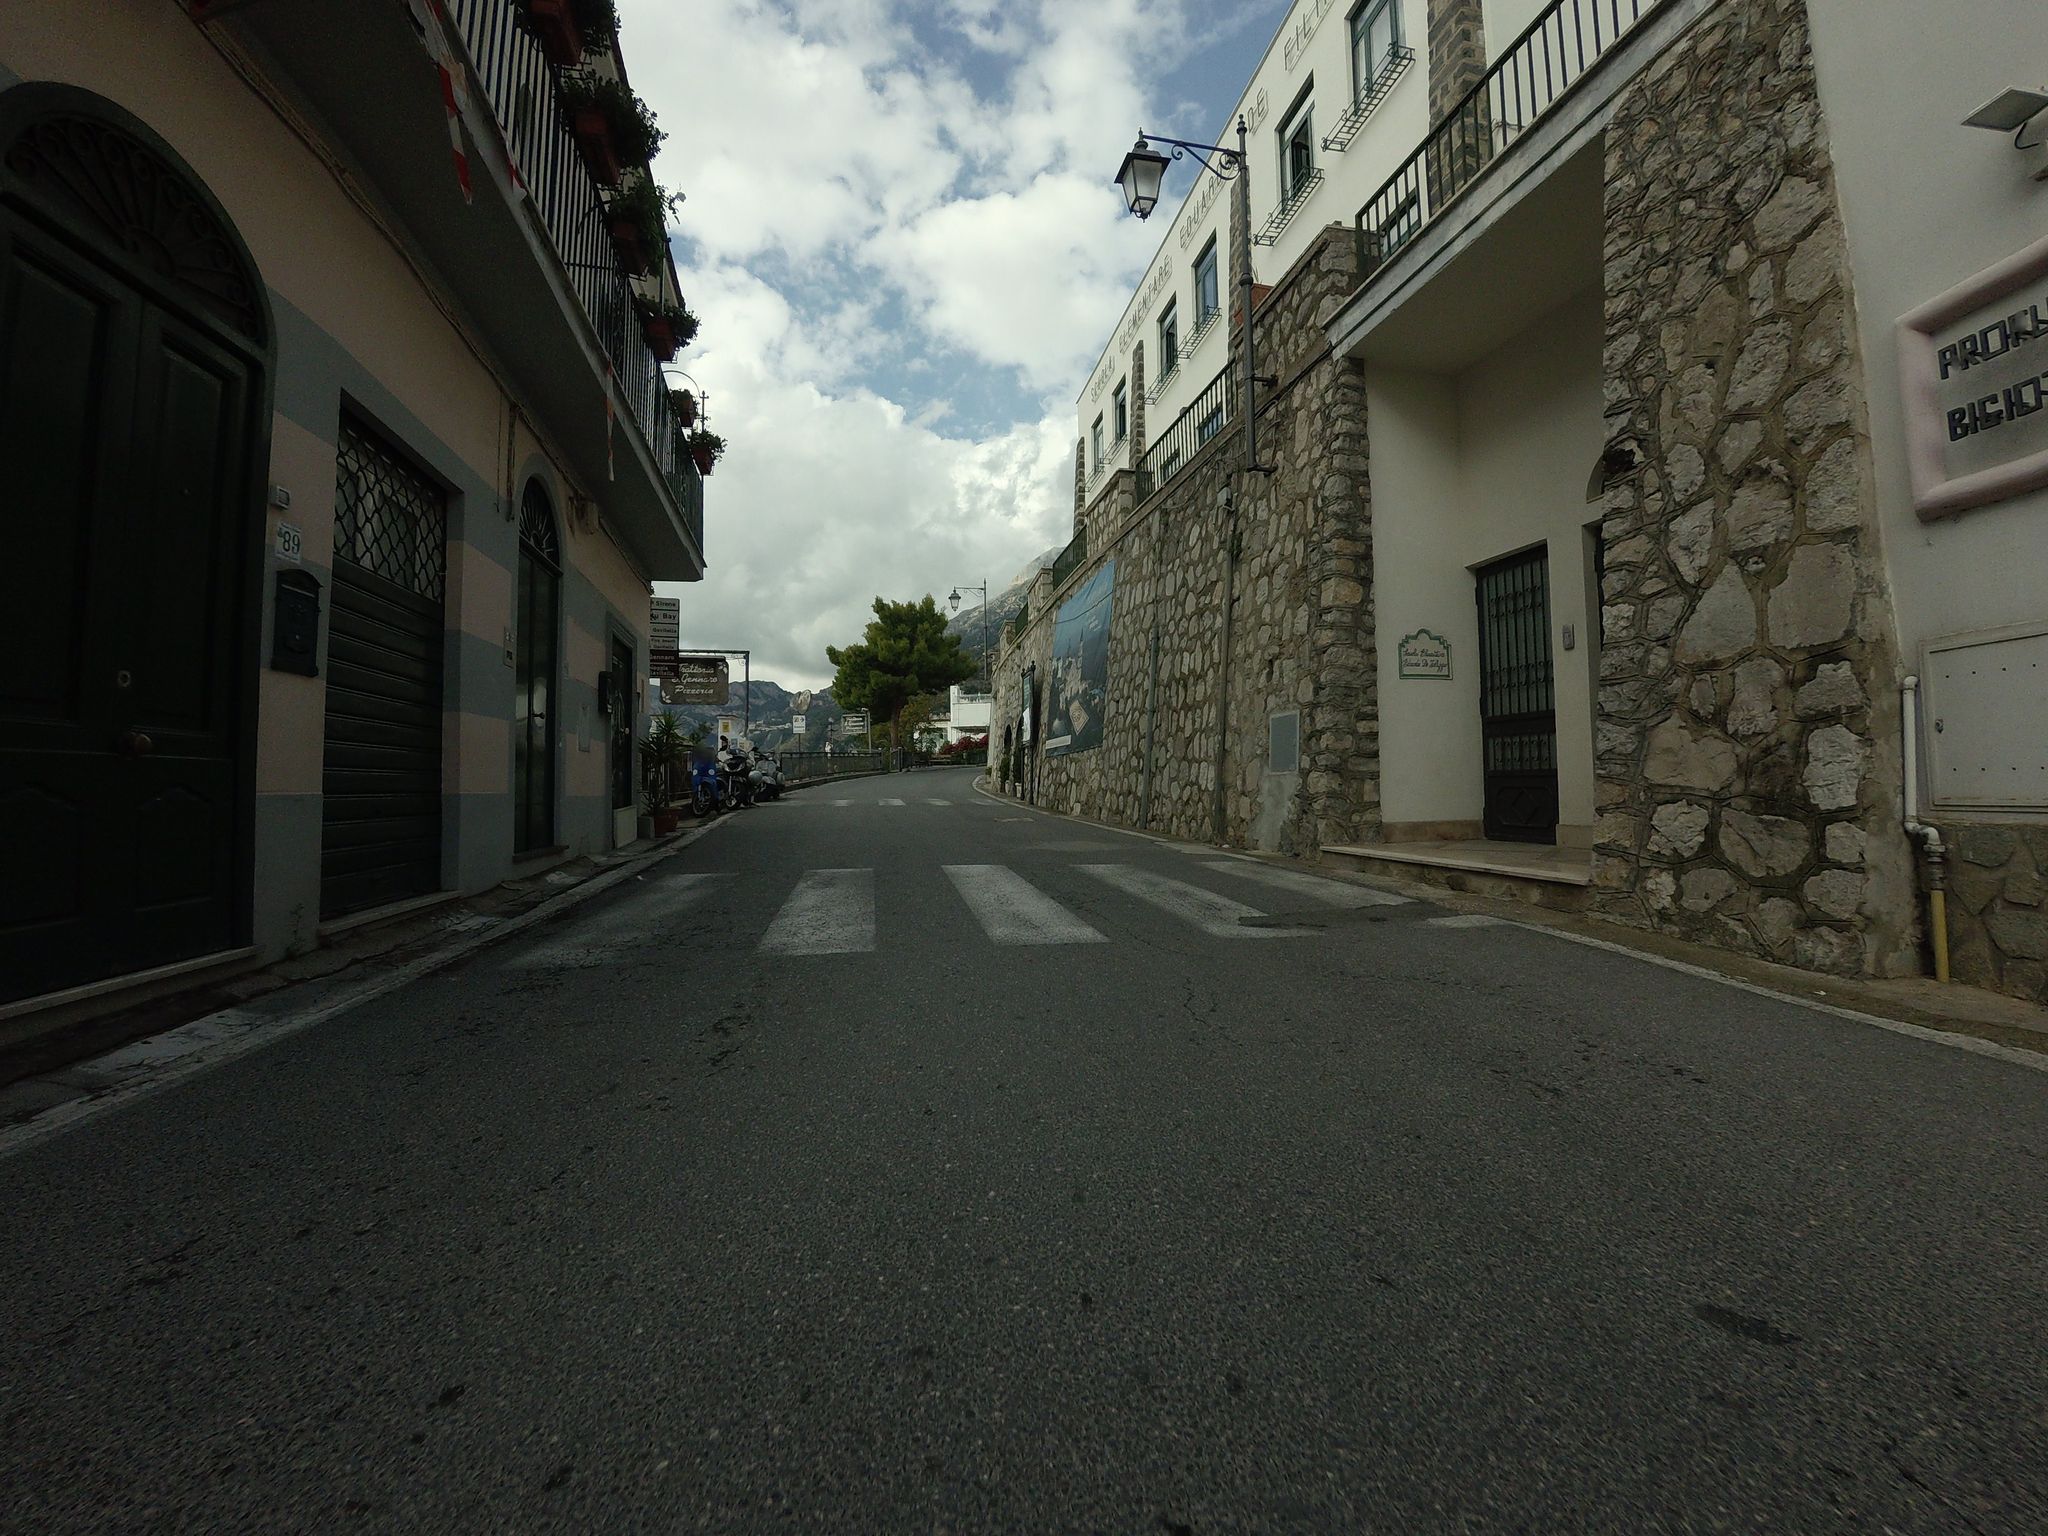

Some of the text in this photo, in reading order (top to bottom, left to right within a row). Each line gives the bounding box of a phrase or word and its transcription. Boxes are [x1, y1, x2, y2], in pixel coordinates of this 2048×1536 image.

[1180, 153, 1231, 249] EDUARD
[1247, 87, 1265, 134] DE
[1284, 0, 1328, 71] FILI
[1946, 370, 2048, 442] BIGIO
[282, 530, 301, 555] 89
[662, 612, 677, 621] Bay
[679, 663, 714, 673] Trattoria
[681, 673, 718, 685] Gennaro
[674, 685, 714, 695] Pizzeria
